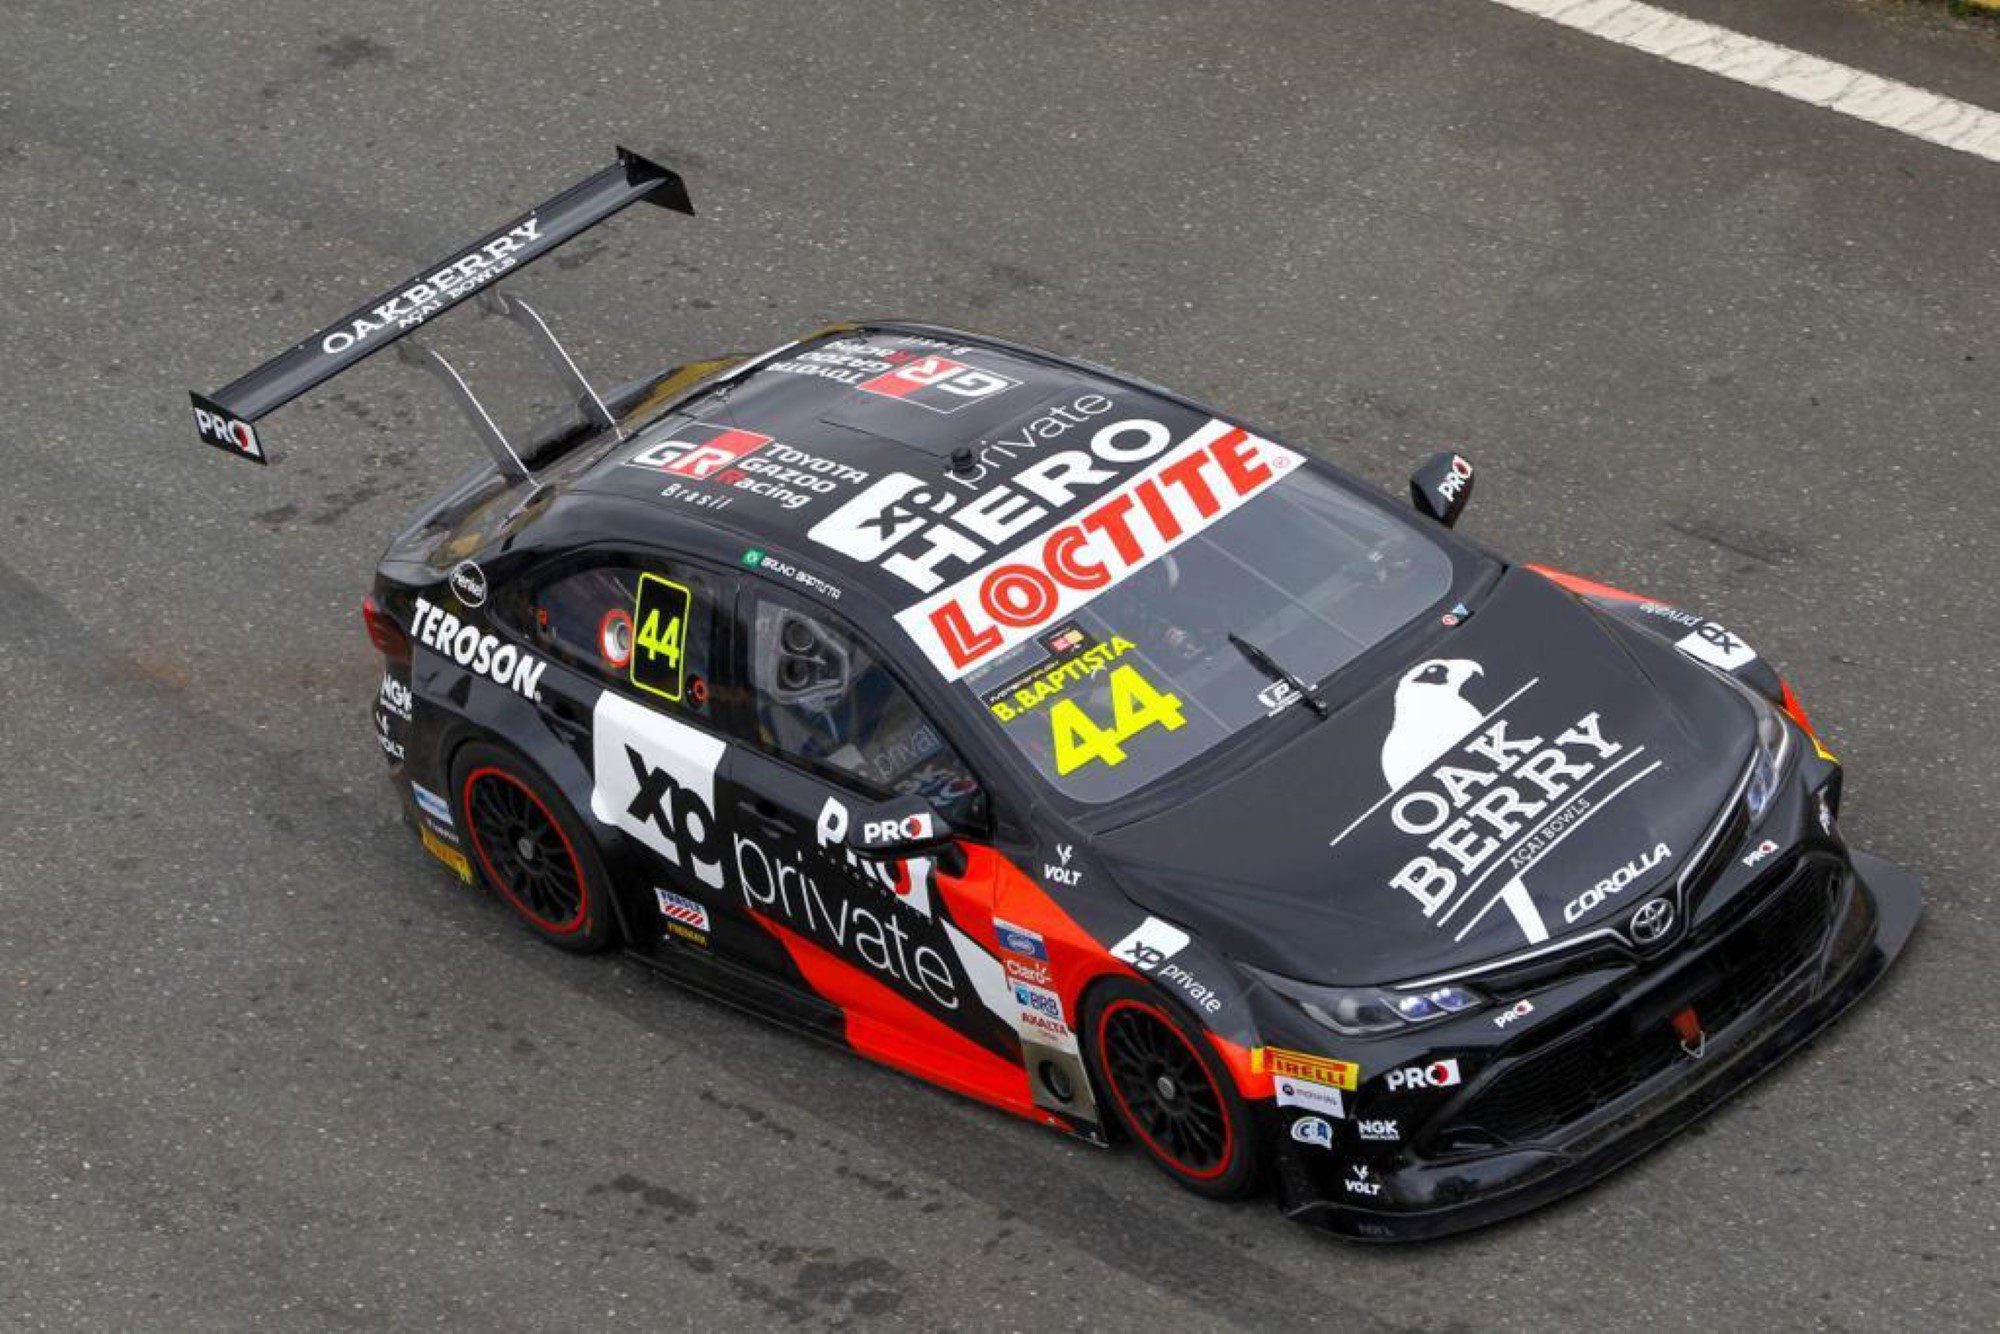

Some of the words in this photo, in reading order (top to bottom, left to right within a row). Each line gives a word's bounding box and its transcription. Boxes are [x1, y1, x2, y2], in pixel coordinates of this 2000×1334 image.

[322, 218, 543, 355] OAKBERRY
[447, 257, 516, 299] BOWLS
[895, 356, 1009, 397] GR
[195, 407, 262, 456] PRO
[943, 391, 1113, 491] private
[632, 440, 738, 477] GR
[736, 457, 838, 494] GAZOO
[762, 442, 870, 486] TOYOTA
[1437, 454, 1474, 502] PRO
[660, 482, 733, 512] Brasil
[717, 469, 812, 510] Racing
[881, 418, 1170, 594] HERO
[929, 426, 1273, 672] LOCTITE
[410, 596, 547, 701] TEROSON
[636, 607, 681, 669] 44
[990, 635, 1138, 722] B.BAPTISTA
[1049, 664, 1188, 776] 44
[1390, 719, 1544, 835] OAK
[864, 813, 933, 844] PRO
[1389, 711, 1624, 916] BERRY
[1541, 798, 1590, 840] BOWLS
[1043, 864, 1083, 887] VOLT
[1562, 841, 1672, 924] COROLLA
[733, 832, 960, 1010] private
[1157, 963, 1221, 1014] private
[1493, 999, 1534, 1029] PRO
[1264, 1047, 1349, 1088] PIRELLI
[1386, 1058, 1462, 1092] PRO
[1358, 1119, 1399, 1135] NGK
[1344, 1179, 1382, 1196] VOLT
